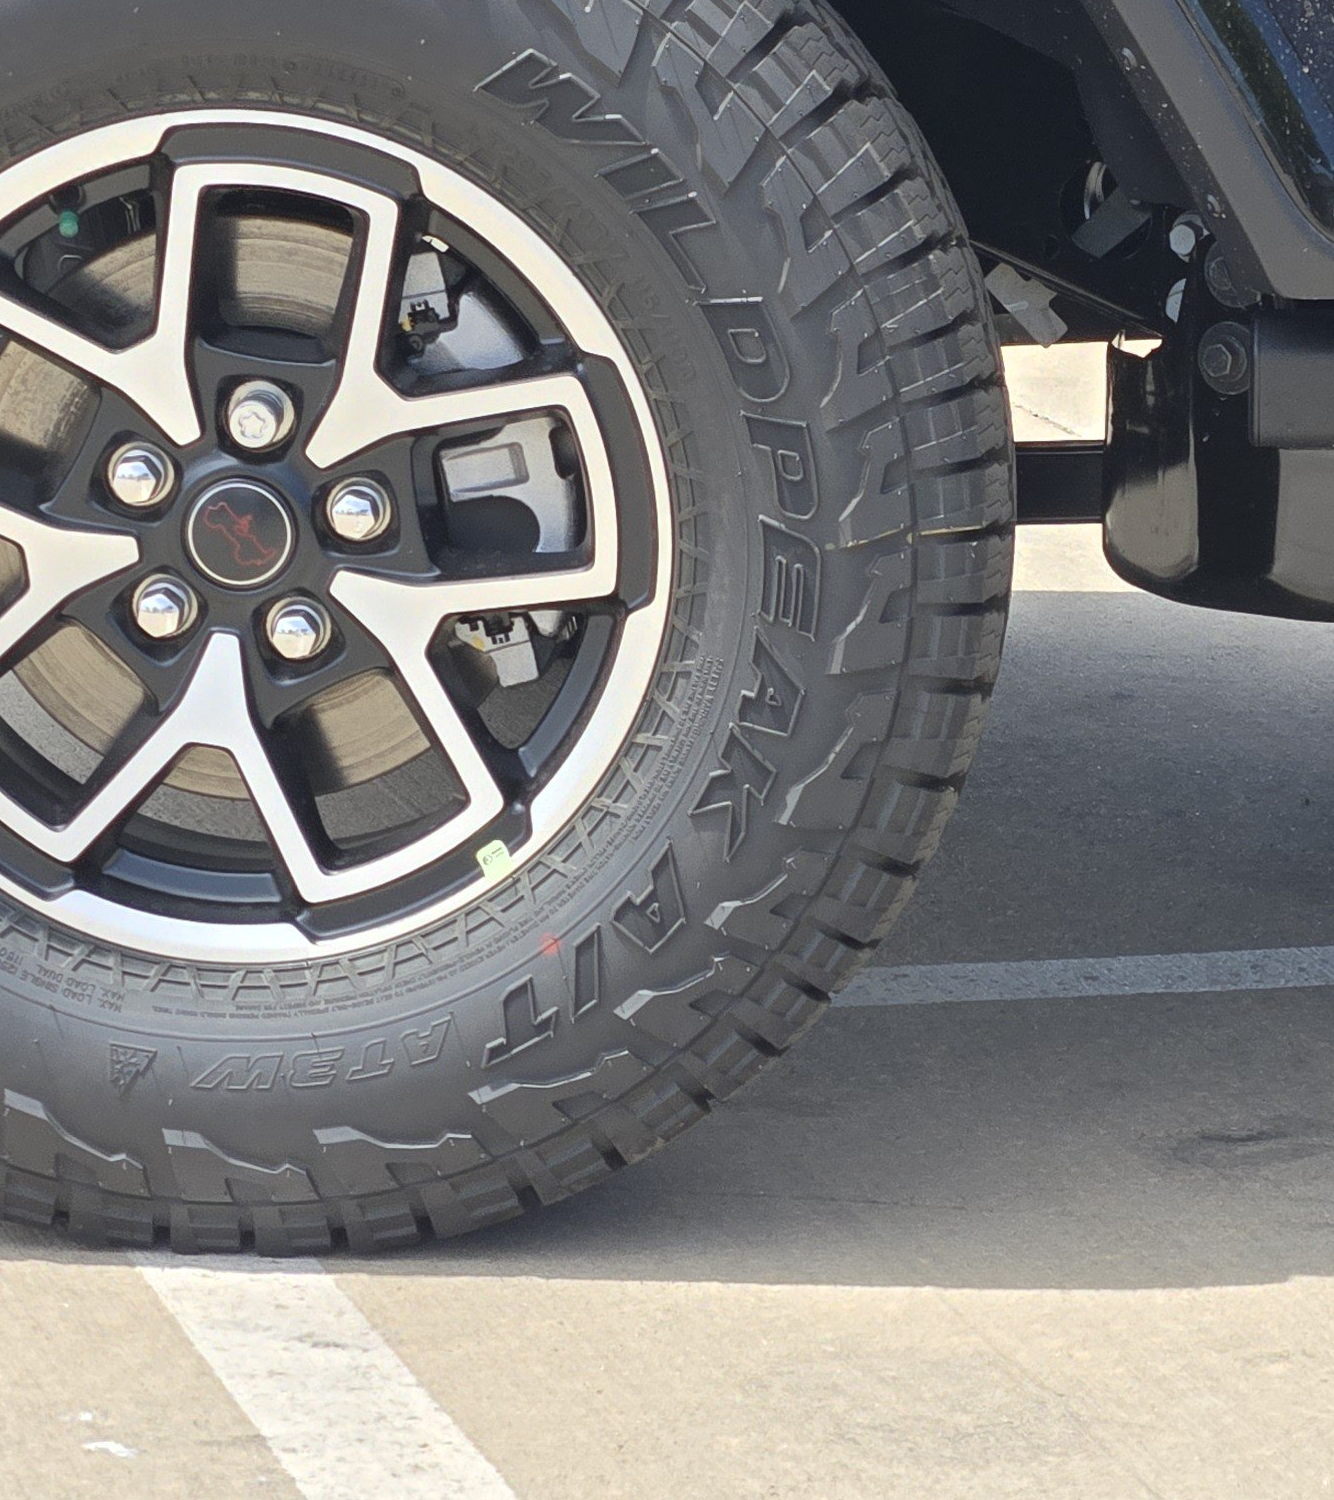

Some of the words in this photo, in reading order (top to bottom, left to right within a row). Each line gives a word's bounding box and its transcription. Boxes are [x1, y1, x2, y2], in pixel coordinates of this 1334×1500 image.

[472, 48, 823, 863] WILDPEAK
[64, 976, 96, 994] LOAD
[480, 836, 688, 1070] A/T
[61, 986, 92, 1005] LOAD
[190, 1011, 455, 1093] AT3W
